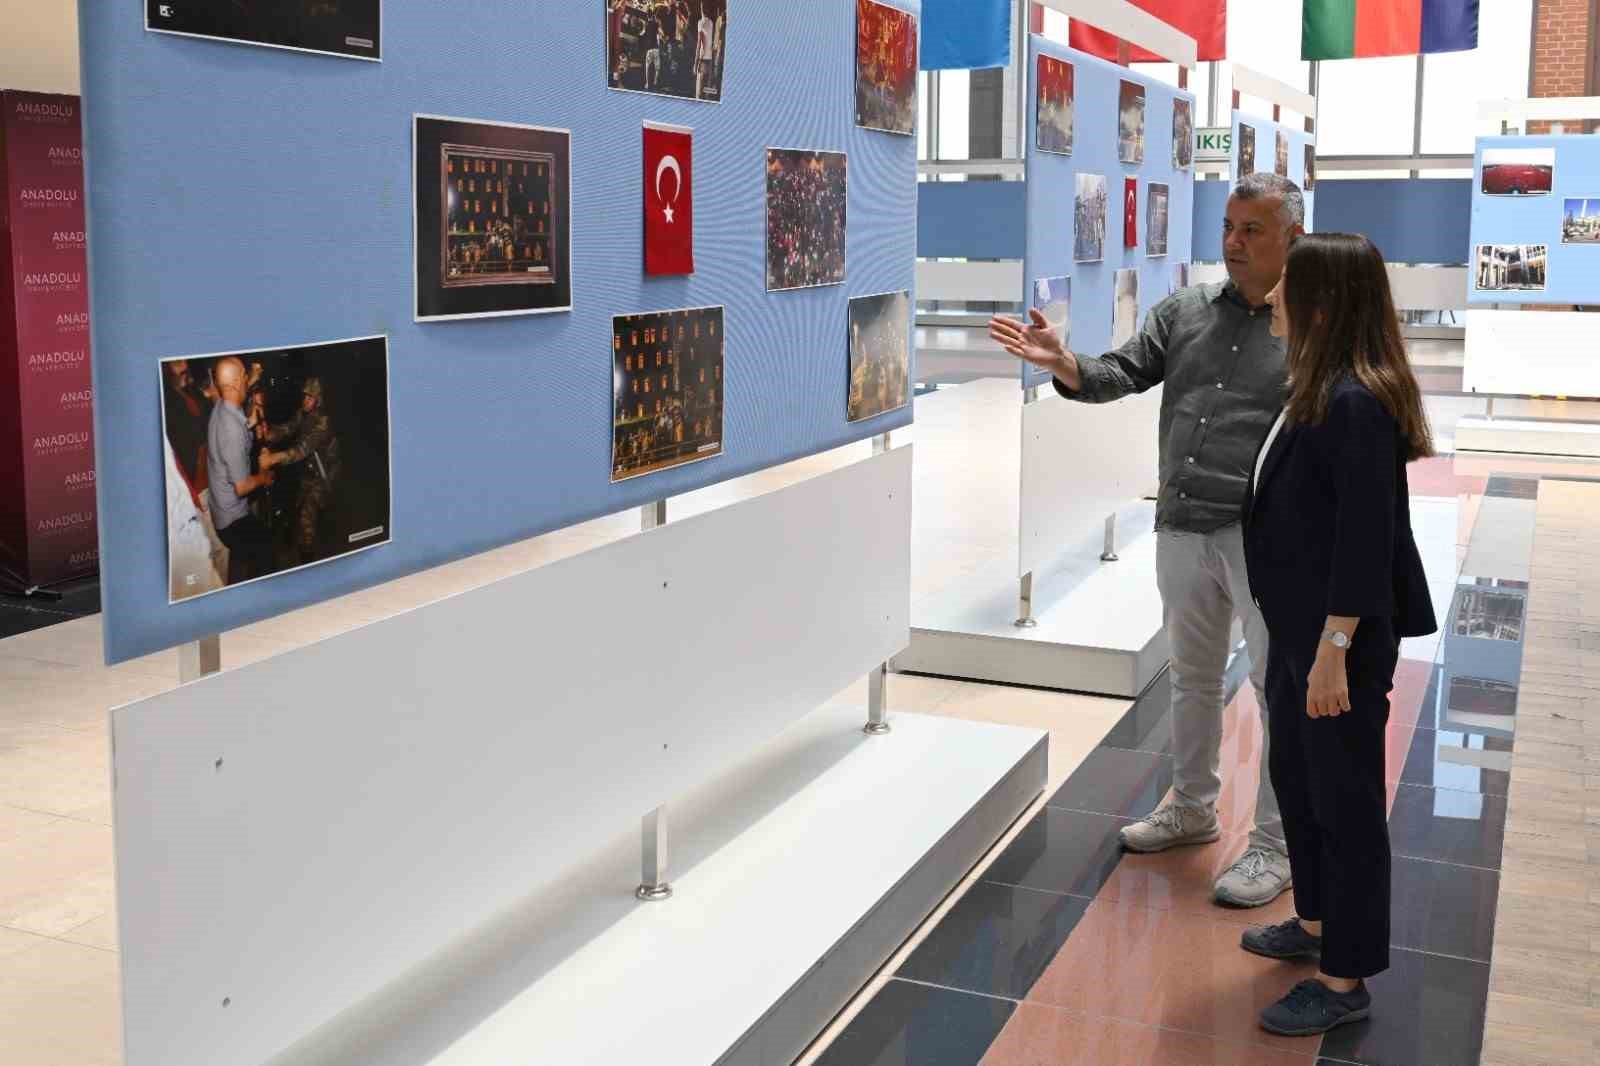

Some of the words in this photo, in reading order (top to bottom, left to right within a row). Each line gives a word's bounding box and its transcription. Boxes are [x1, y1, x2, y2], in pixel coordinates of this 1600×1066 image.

[16, 103, 73, 117] ANADOLU
[1196, 133, 1231, 153] IKIŞ
[47, 146, 81, 159] ANAD
[20, 188, 77, 201] ANADOLU
[52, 231, 88, 242] ANAD
[23, 272, 80, 285] ANADOLU
[56, 313, 89, 325] ANAD
[28, 350, 84, 365] ANADOLU
[60, 390, 92, 403] ANAD
[33, 431, 88, 448] ANADOLU
[64, 470, 96, 485] ANAD
[37, 511, 93, 531] ANADOLU
